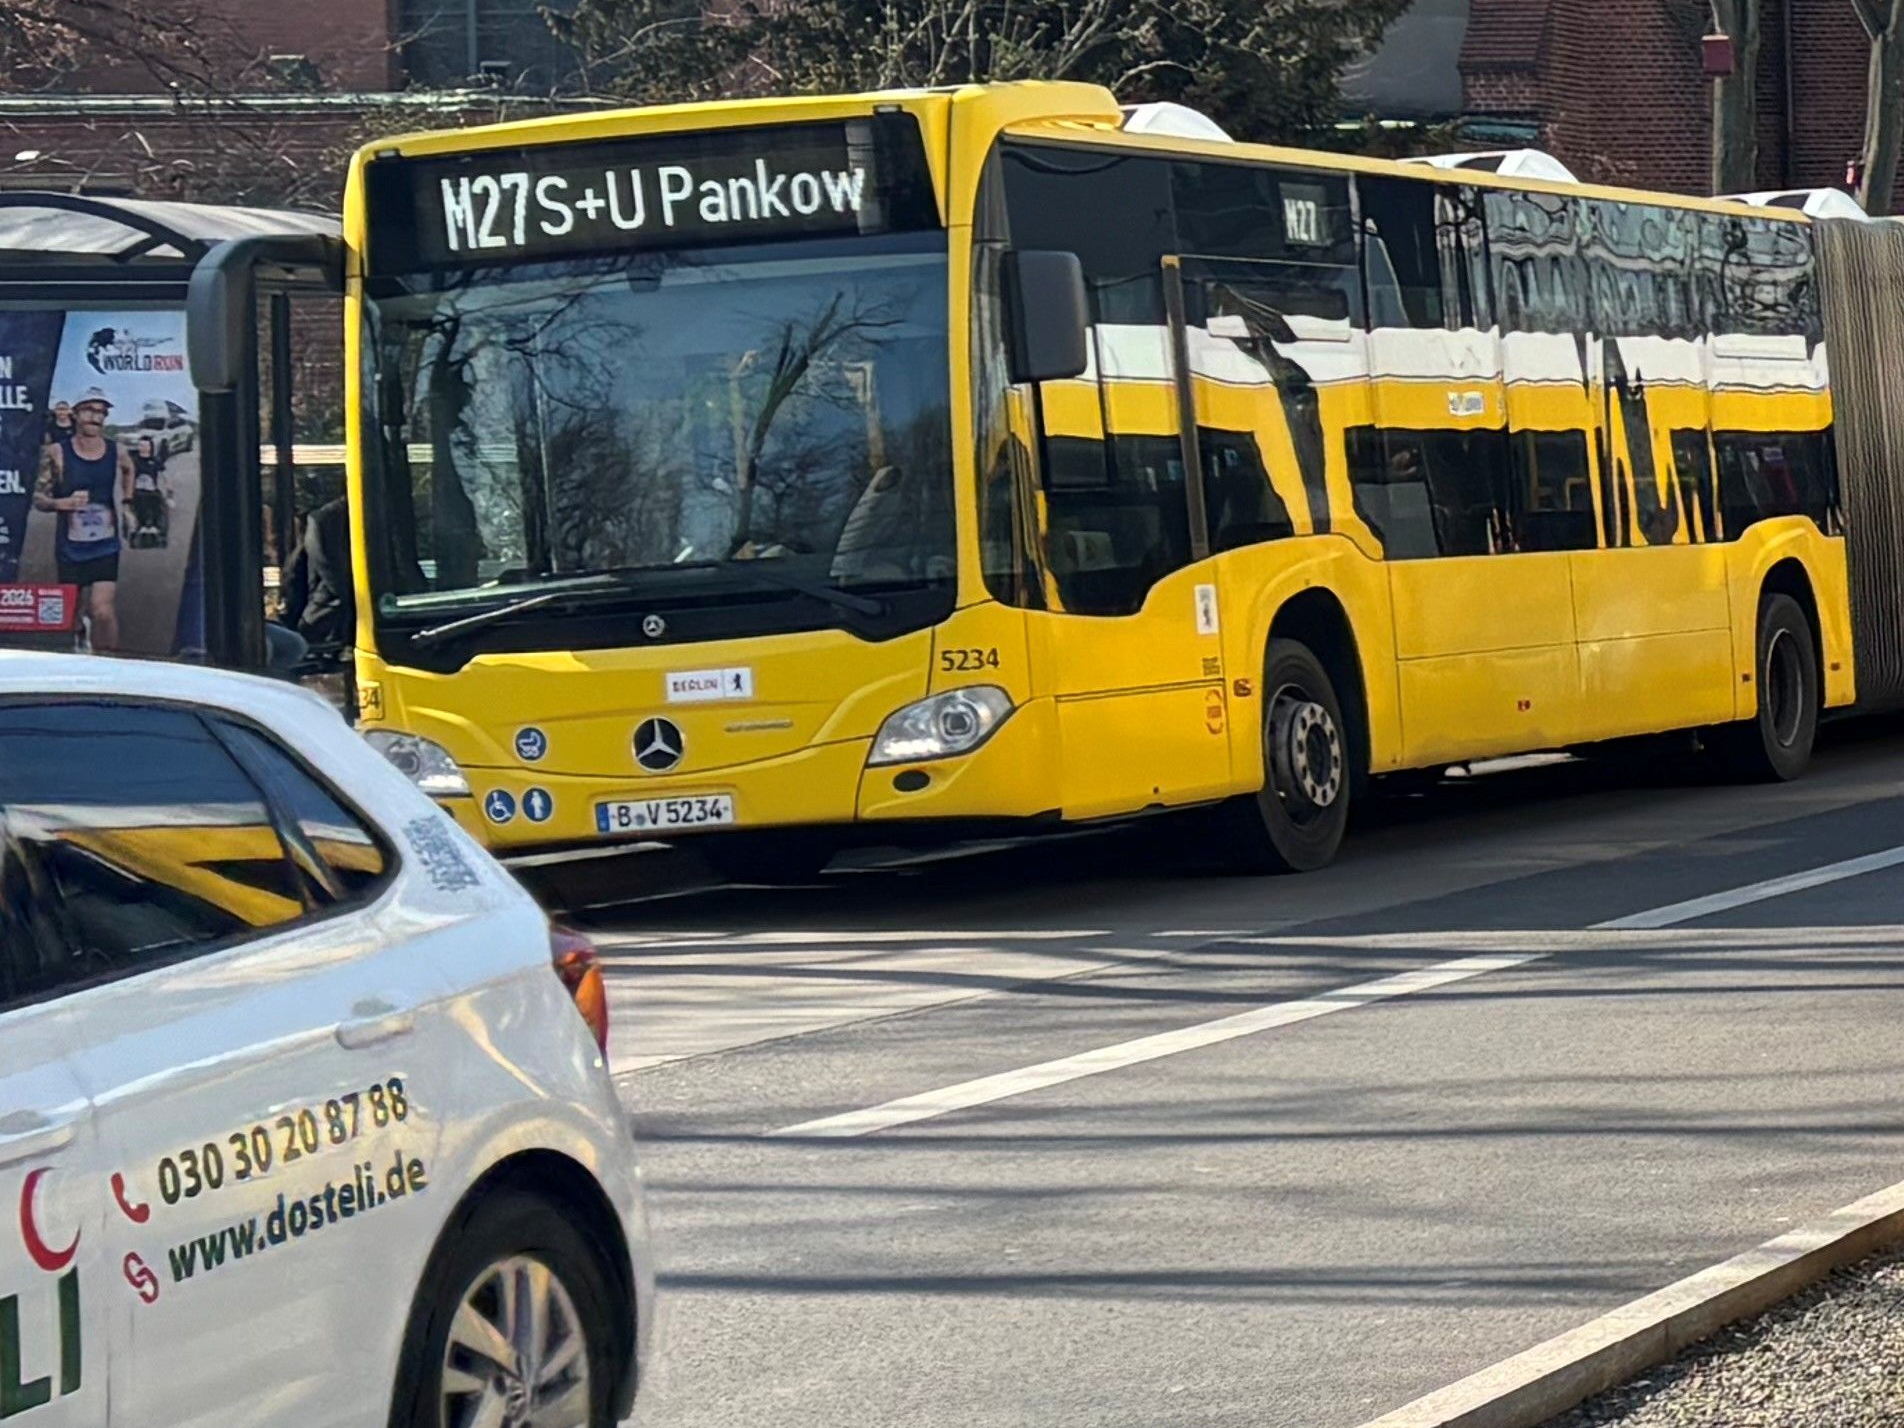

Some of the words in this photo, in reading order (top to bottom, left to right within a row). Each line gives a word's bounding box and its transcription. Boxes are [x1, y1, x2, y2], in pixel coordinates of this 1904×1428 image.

[440, 173, 529, 250] M27
[534, 168, 647, 236] S+U
[658, 159, 866, 226] Pankow
[1284, 198, 1316, 241] M27
[941, 647, 1000, 671] 5234
[617, 805, 632, 827] B
[646, 803, 660, 825] V
[666, 798, 722, 824] 5234
[158, 1143, 224, 1205] 030
[229, 1126, 273, 1179] 30
[275, 1109, 319, 1163] 20
[323, 1092, 361, 1145] 87
[369, 1077, 408, 1128] 88
[168, 1149, 429, 1282] www.dosteli.de
